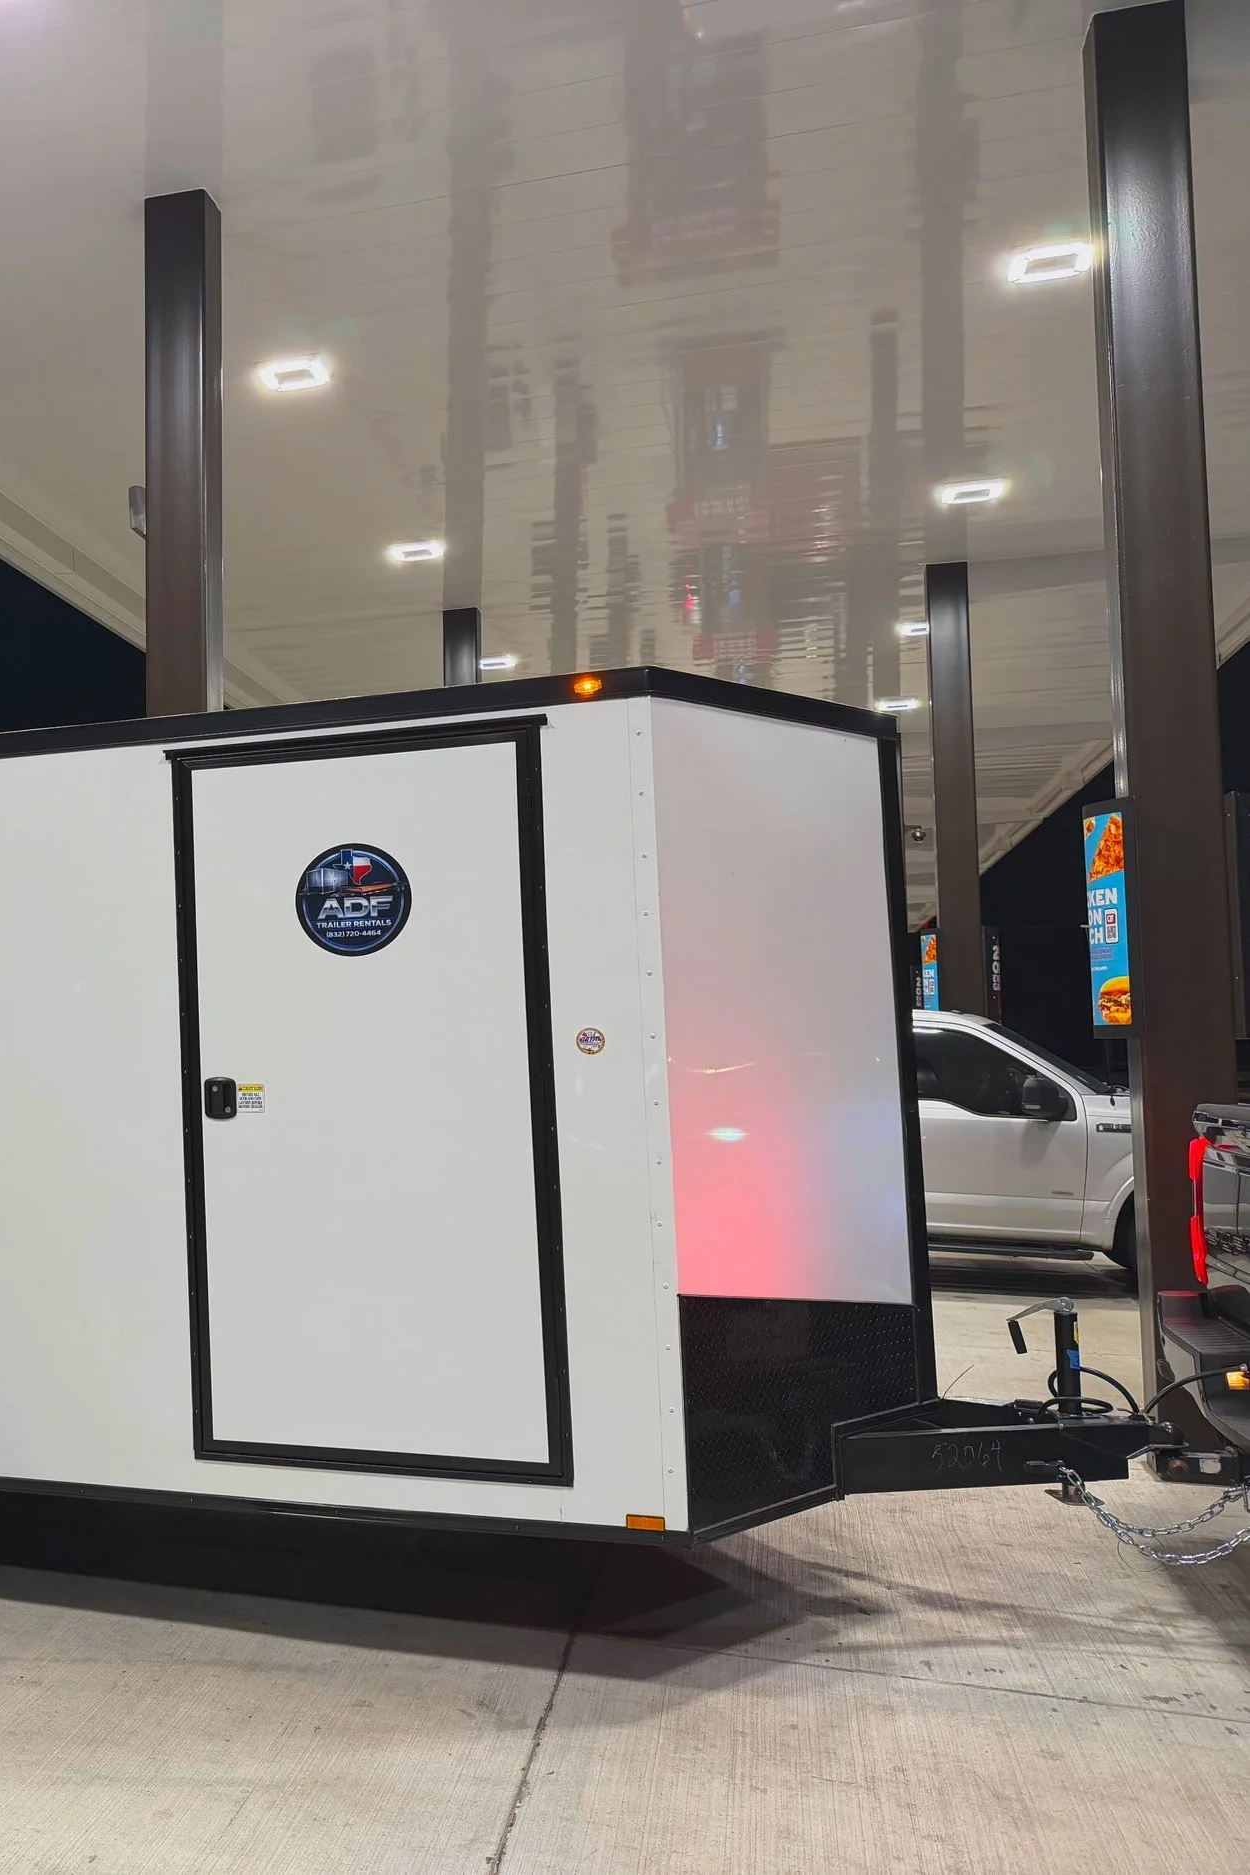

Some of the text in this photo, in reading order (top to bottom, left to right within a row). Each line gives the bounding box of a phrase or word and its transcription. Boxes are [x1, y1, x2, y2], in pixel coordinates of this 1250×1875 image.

[317, 896, 393, 919] ADF
[316, 919, 392, 929] TRAILER RENTALS
